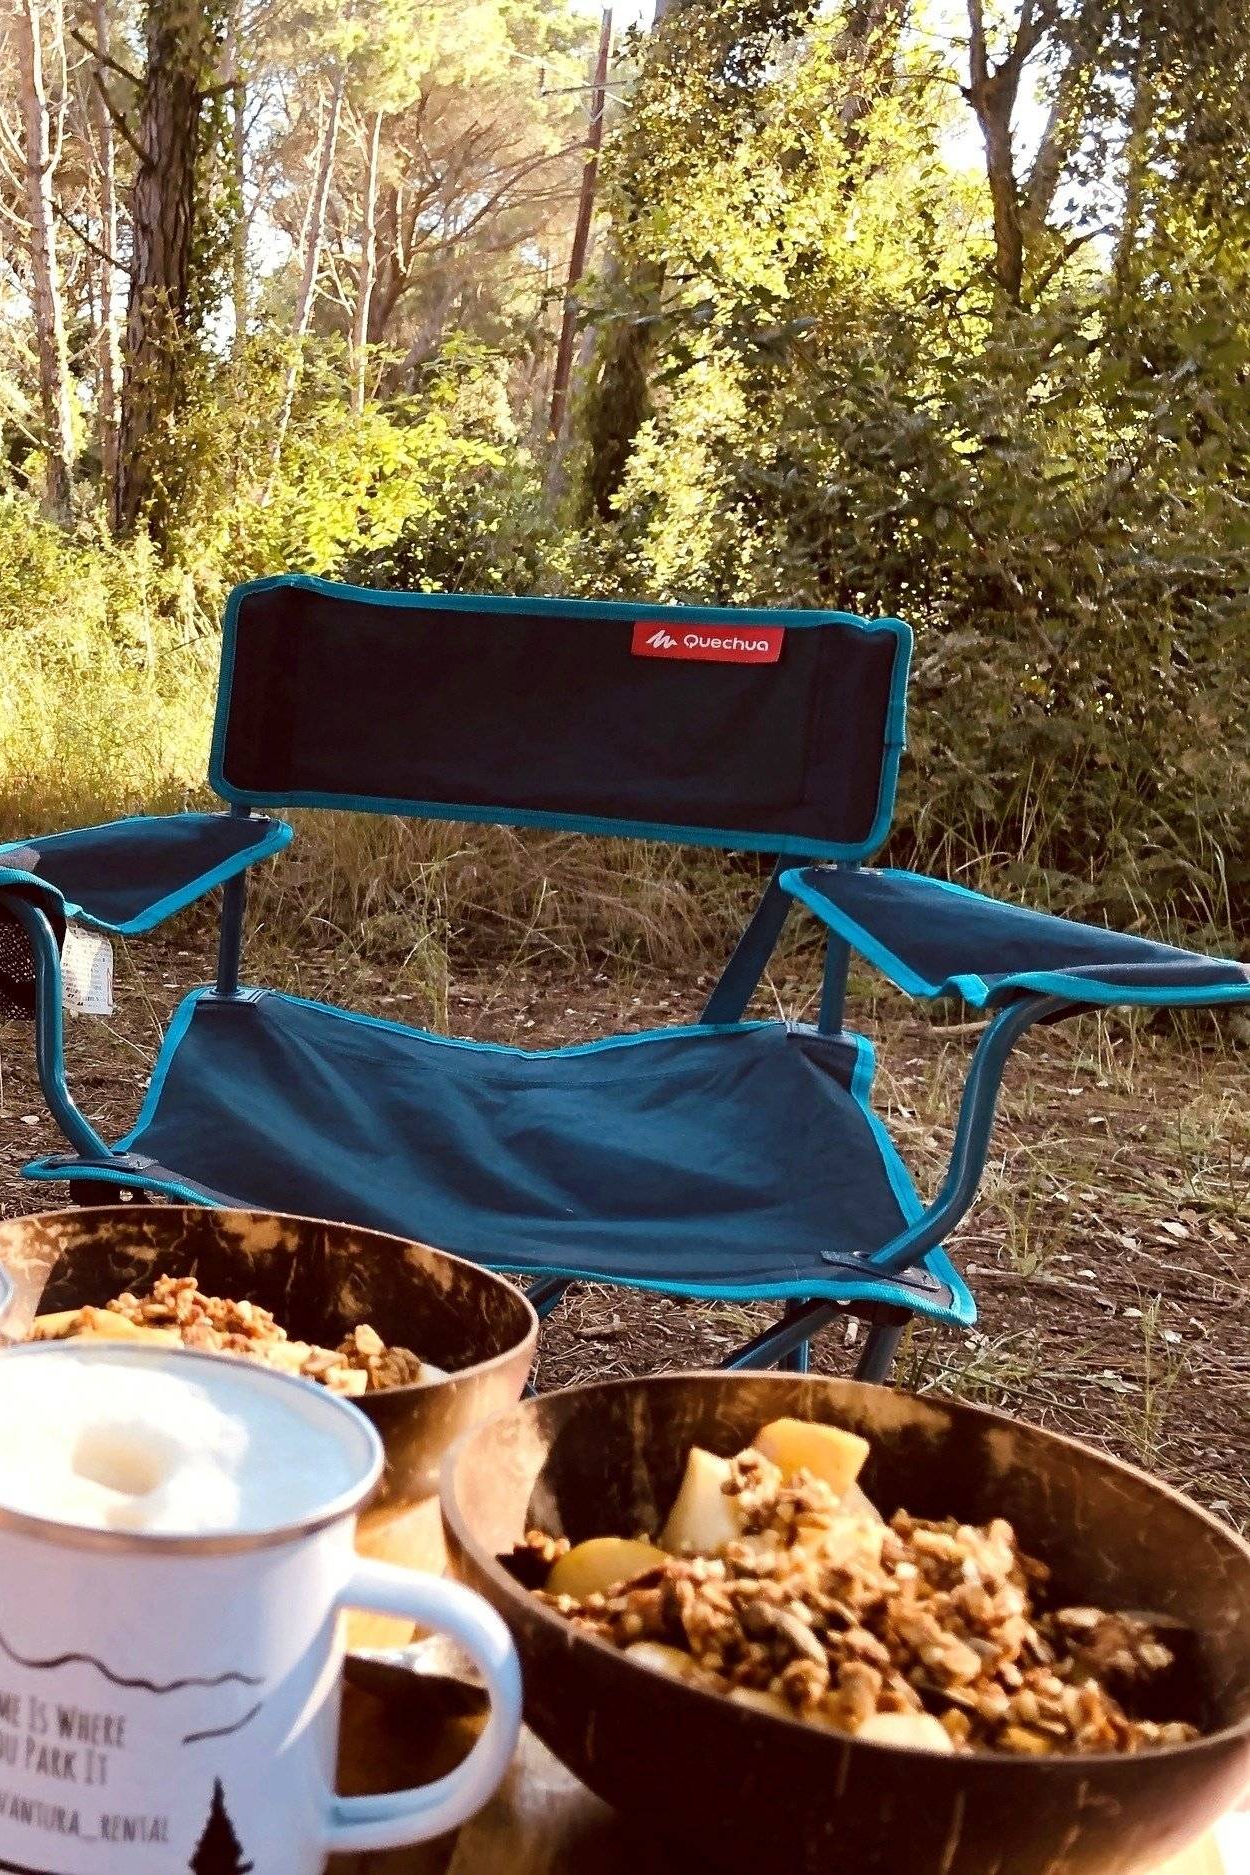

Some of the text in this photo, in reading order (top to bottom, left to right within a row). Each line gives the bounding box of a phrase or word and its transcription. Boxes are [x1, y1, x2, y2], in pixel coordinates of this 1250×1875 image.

[683, 633, 769, 652] Quechua
[28, 1695, 48, 1735] IS
[56, 1703, 126, 1749] WHERE
[25, 1735, 77, 1783] PARK
[84, 1749, 108, 1786] IT
